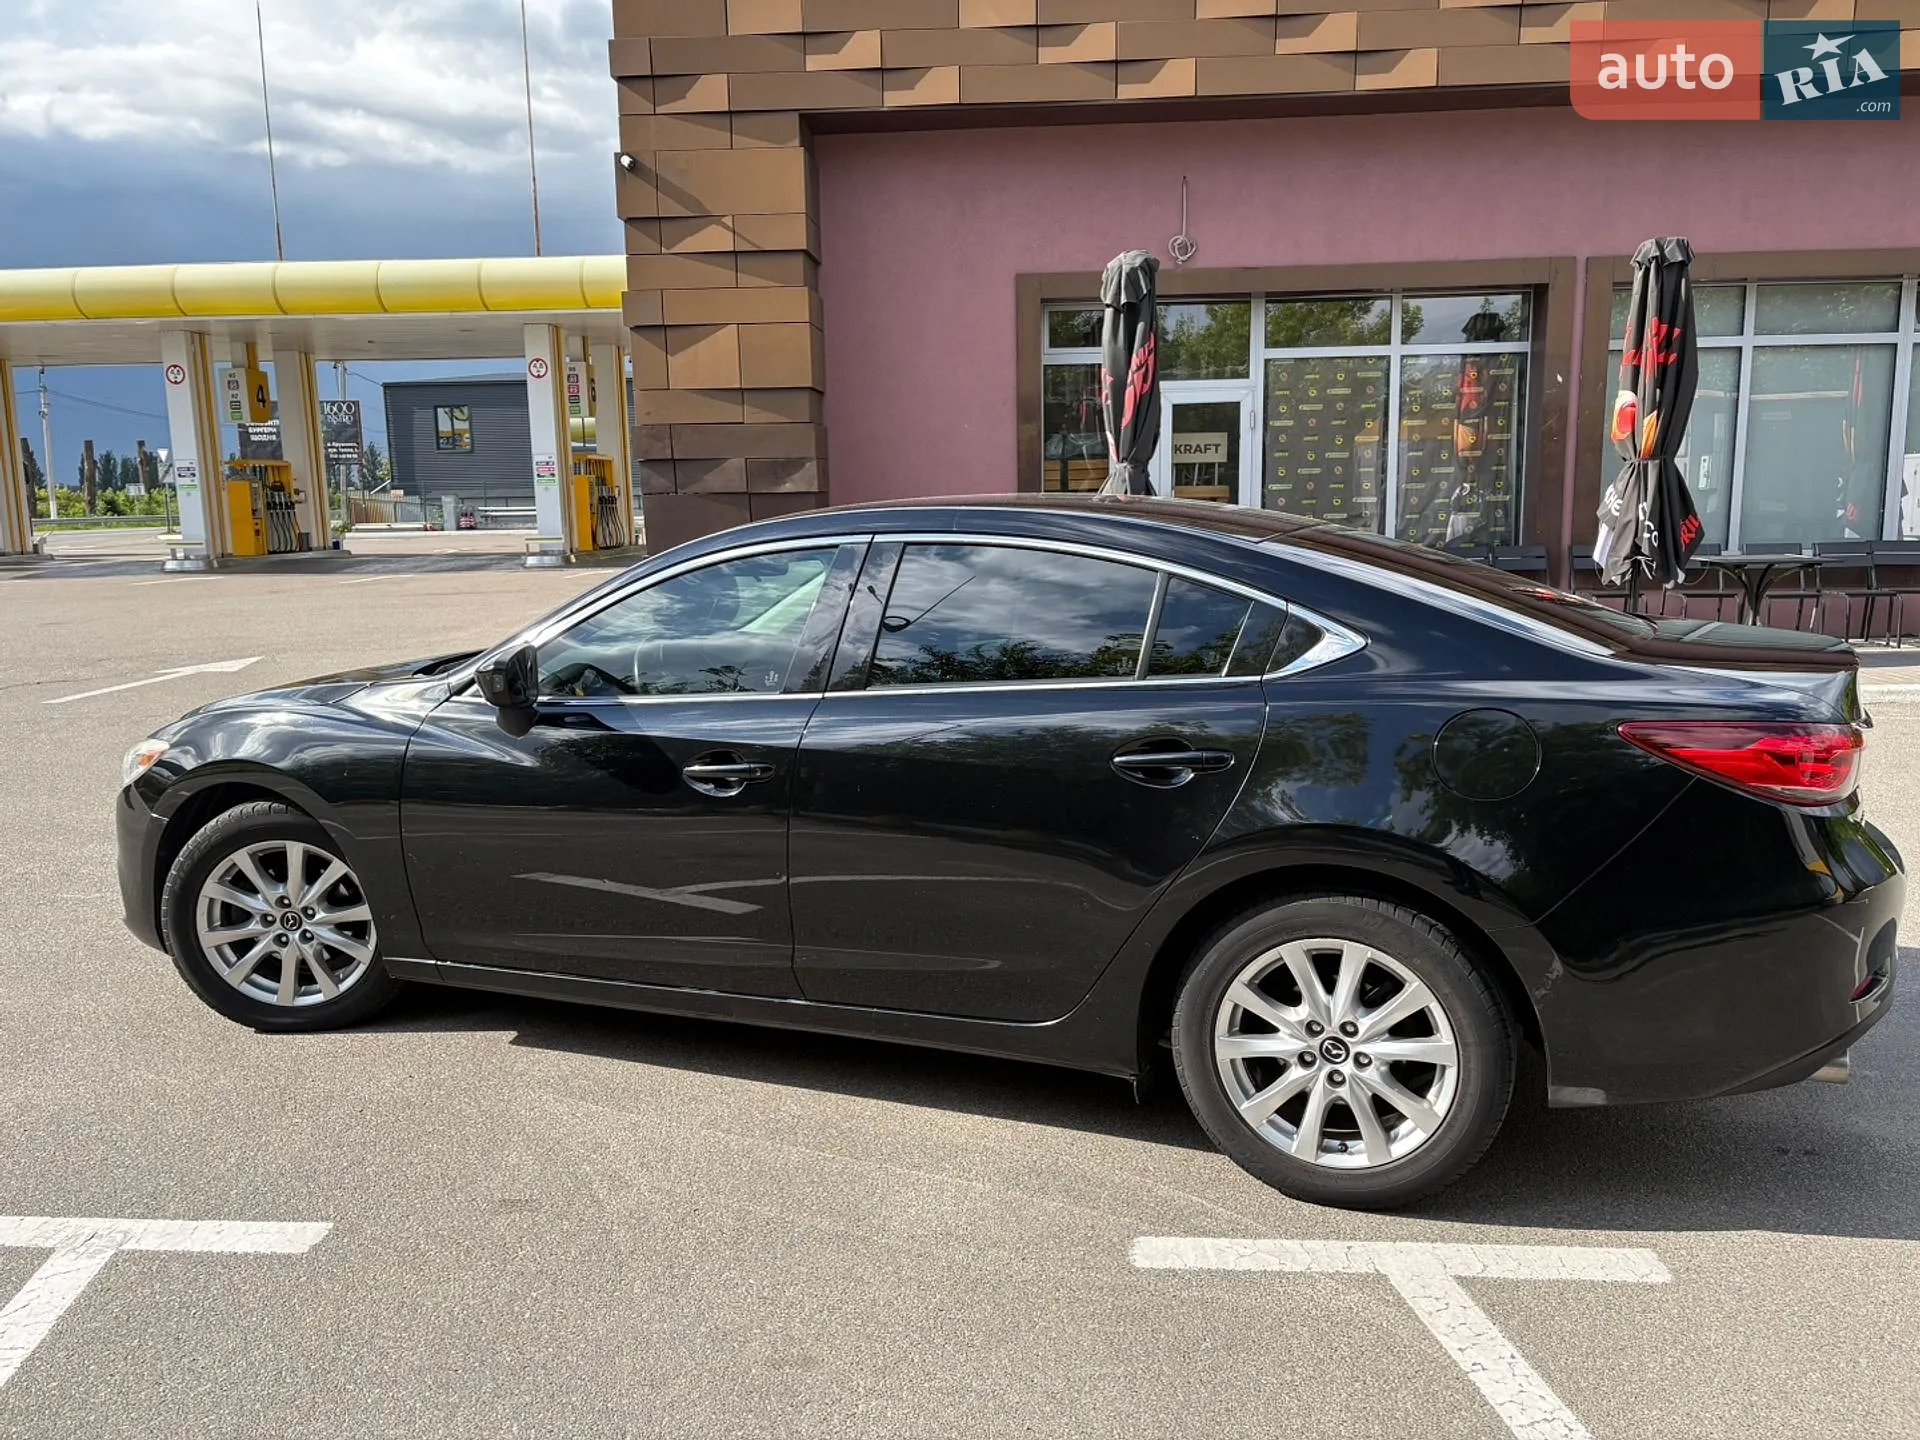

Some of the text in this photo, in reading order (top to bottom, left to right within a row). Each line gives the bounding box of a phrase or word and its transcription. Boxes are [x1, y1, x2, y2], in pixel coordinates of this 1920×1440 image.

[256, 384, 266, 408] 4
[323, 402, 355, 415] 1600
[1174, 443, 1221, 454] KRAFT
